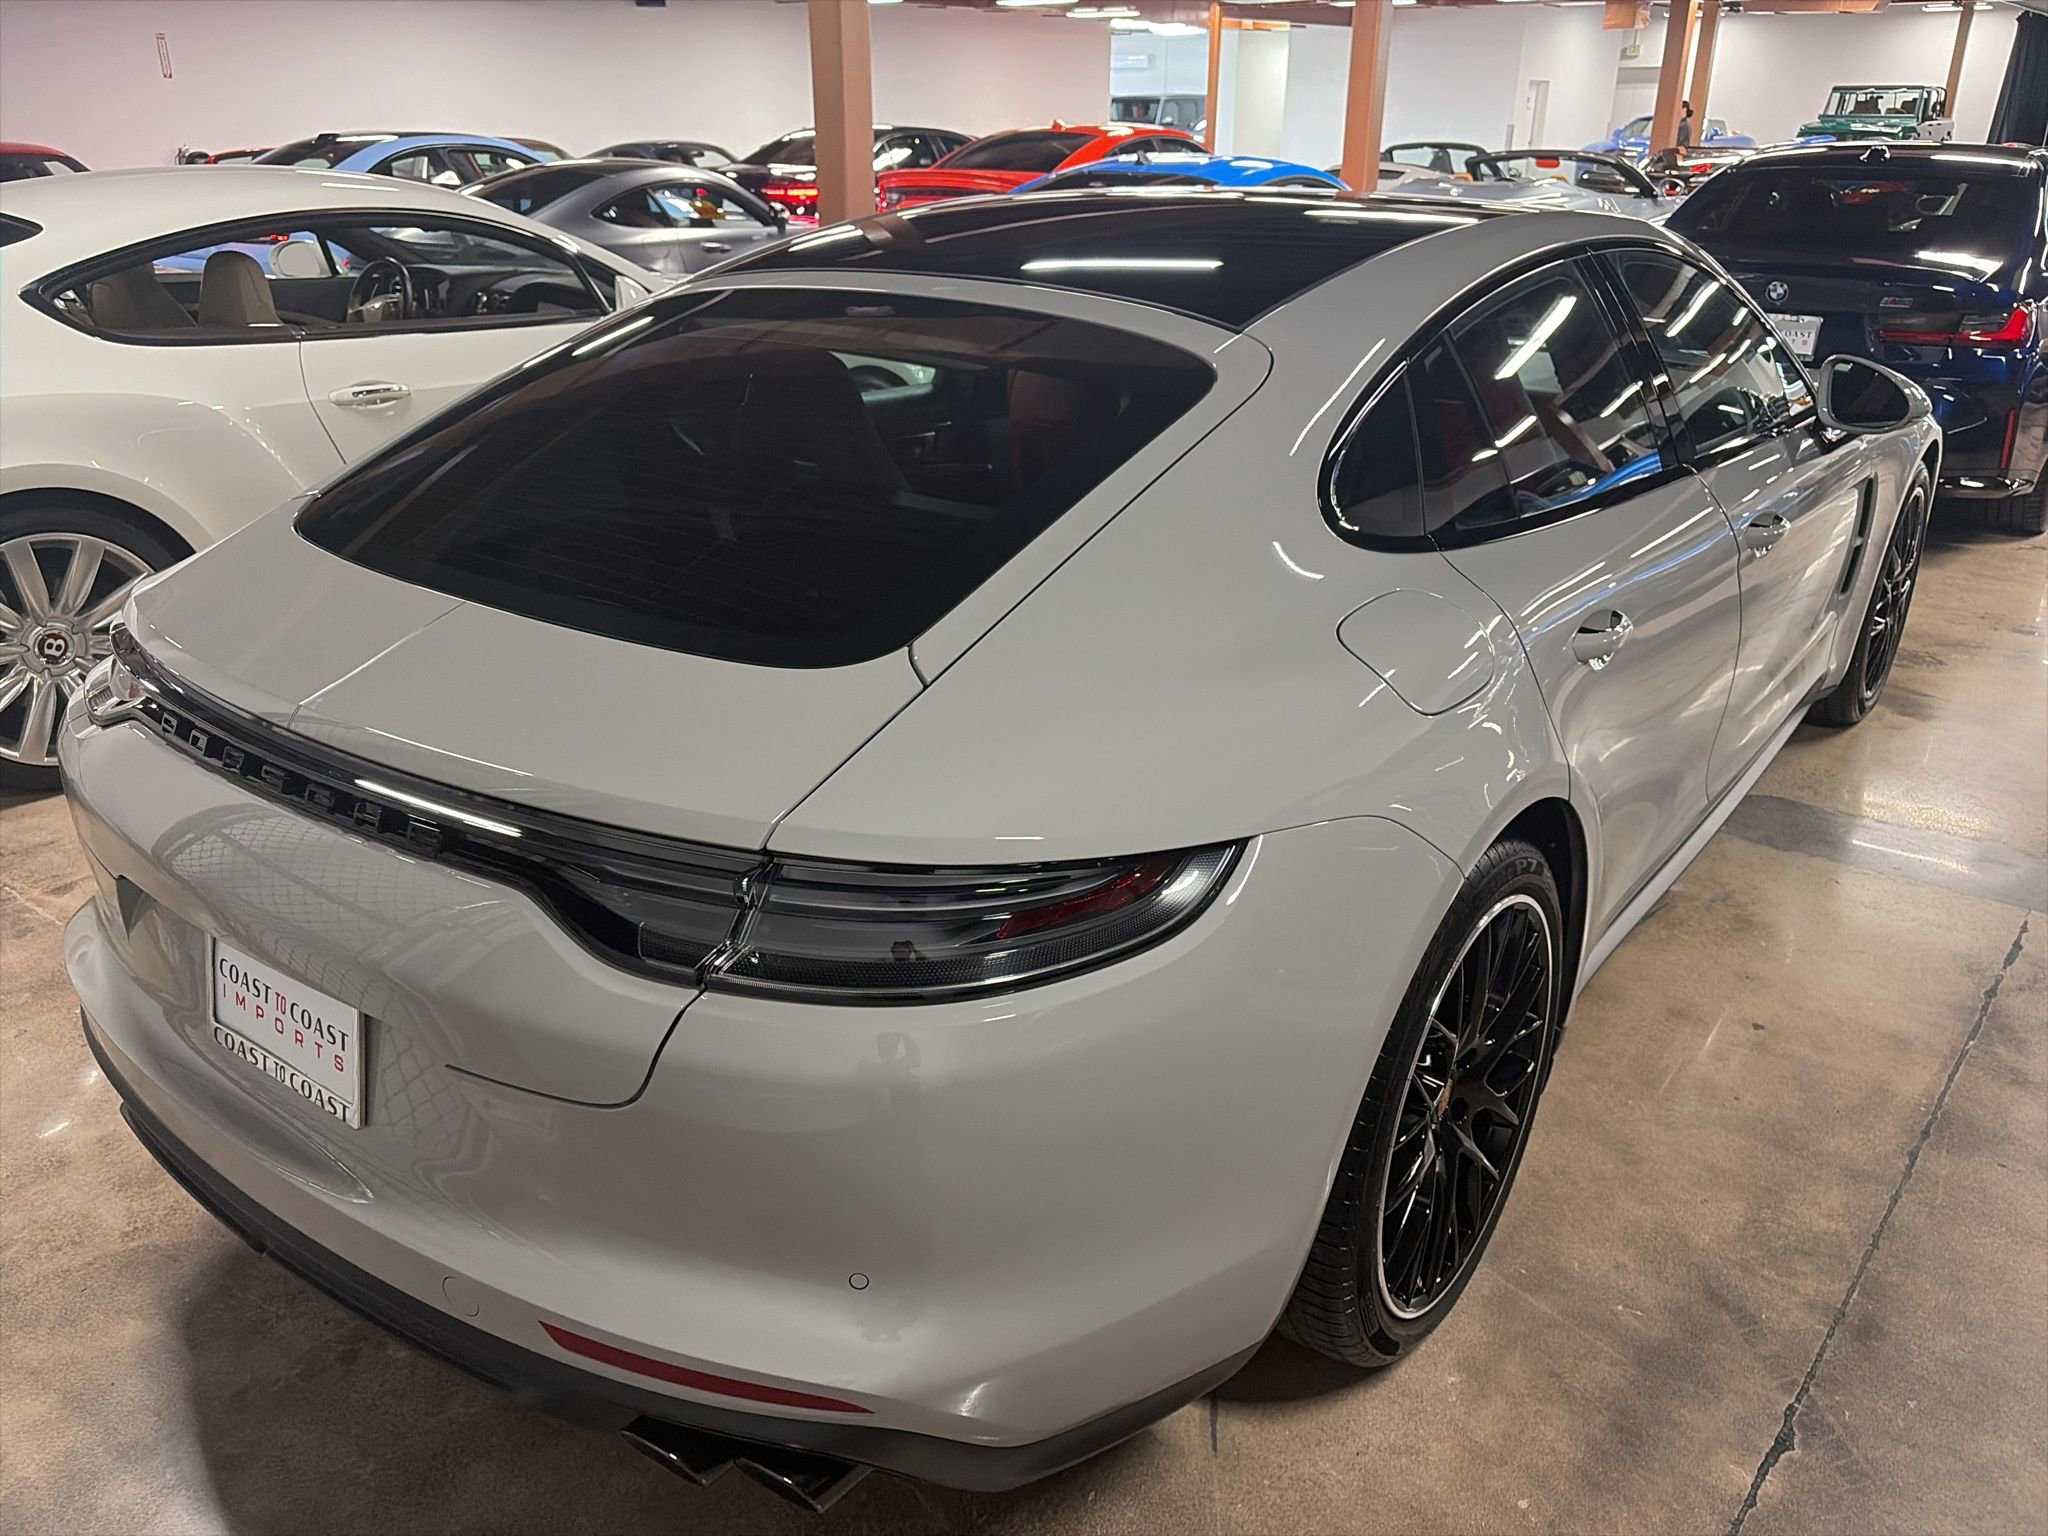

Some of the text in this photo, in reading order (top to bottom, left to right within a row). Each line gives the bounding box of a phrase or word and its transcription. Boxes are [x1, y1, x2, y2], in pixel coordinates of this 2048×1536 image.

[44, 637, 65, 657] B
[1515, 858, 1538, 874] P7
[219, 957, 349, 1052] COAST TO COAST
[223, 983, 344, 1073] IMPORTS
[213, 1026, 350, 1122] COAST TO COAST
